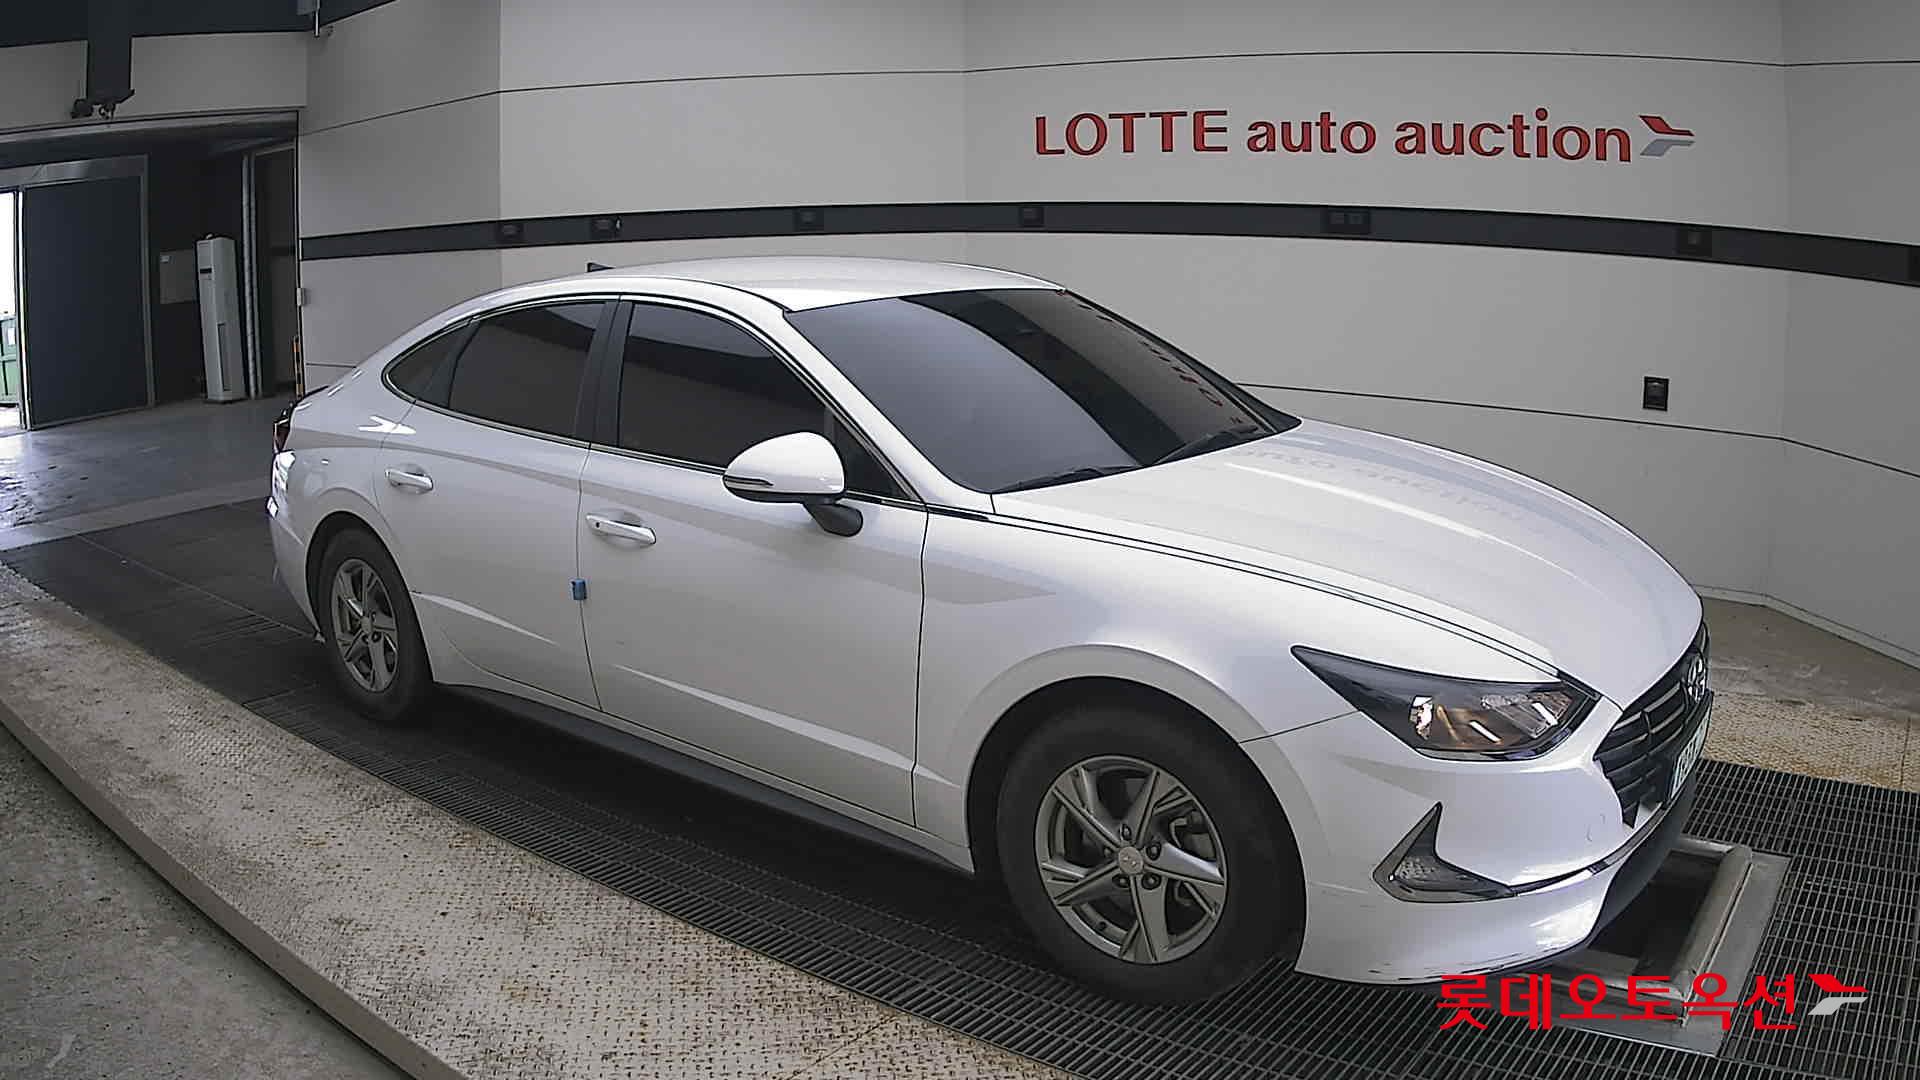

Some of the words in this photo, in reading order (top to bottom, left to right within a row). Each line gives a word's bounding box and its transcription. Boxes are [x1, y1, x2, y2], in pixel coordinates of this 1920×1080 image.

[1034, 109, 1229, 157] LOTTE
[1246, 111, 1378, 155] auto
[1394, 108, 1633, 163] auction
